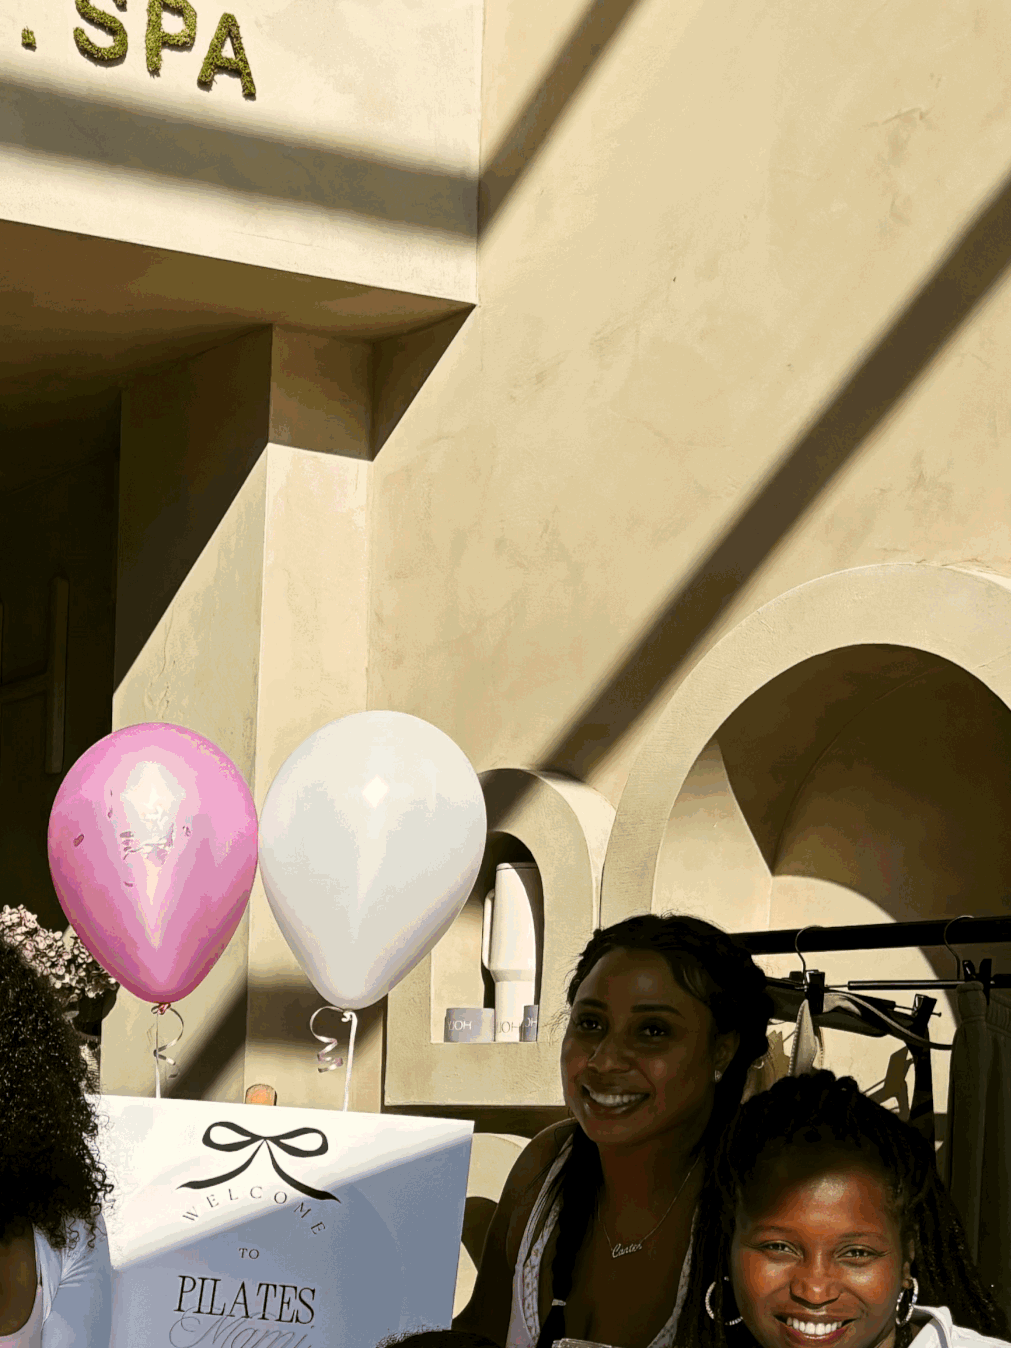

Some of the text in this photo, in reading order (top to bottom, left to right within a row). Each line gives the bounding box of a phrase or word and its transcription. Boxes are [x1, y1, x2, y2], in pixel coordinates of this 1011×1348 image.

[73, 0, 256, 100] SPA
[182, 1186, 326, 1235] WELCOME
[238, 1248, 260, 1260] TO
[173, 1275, 316, 1325] PILATES
